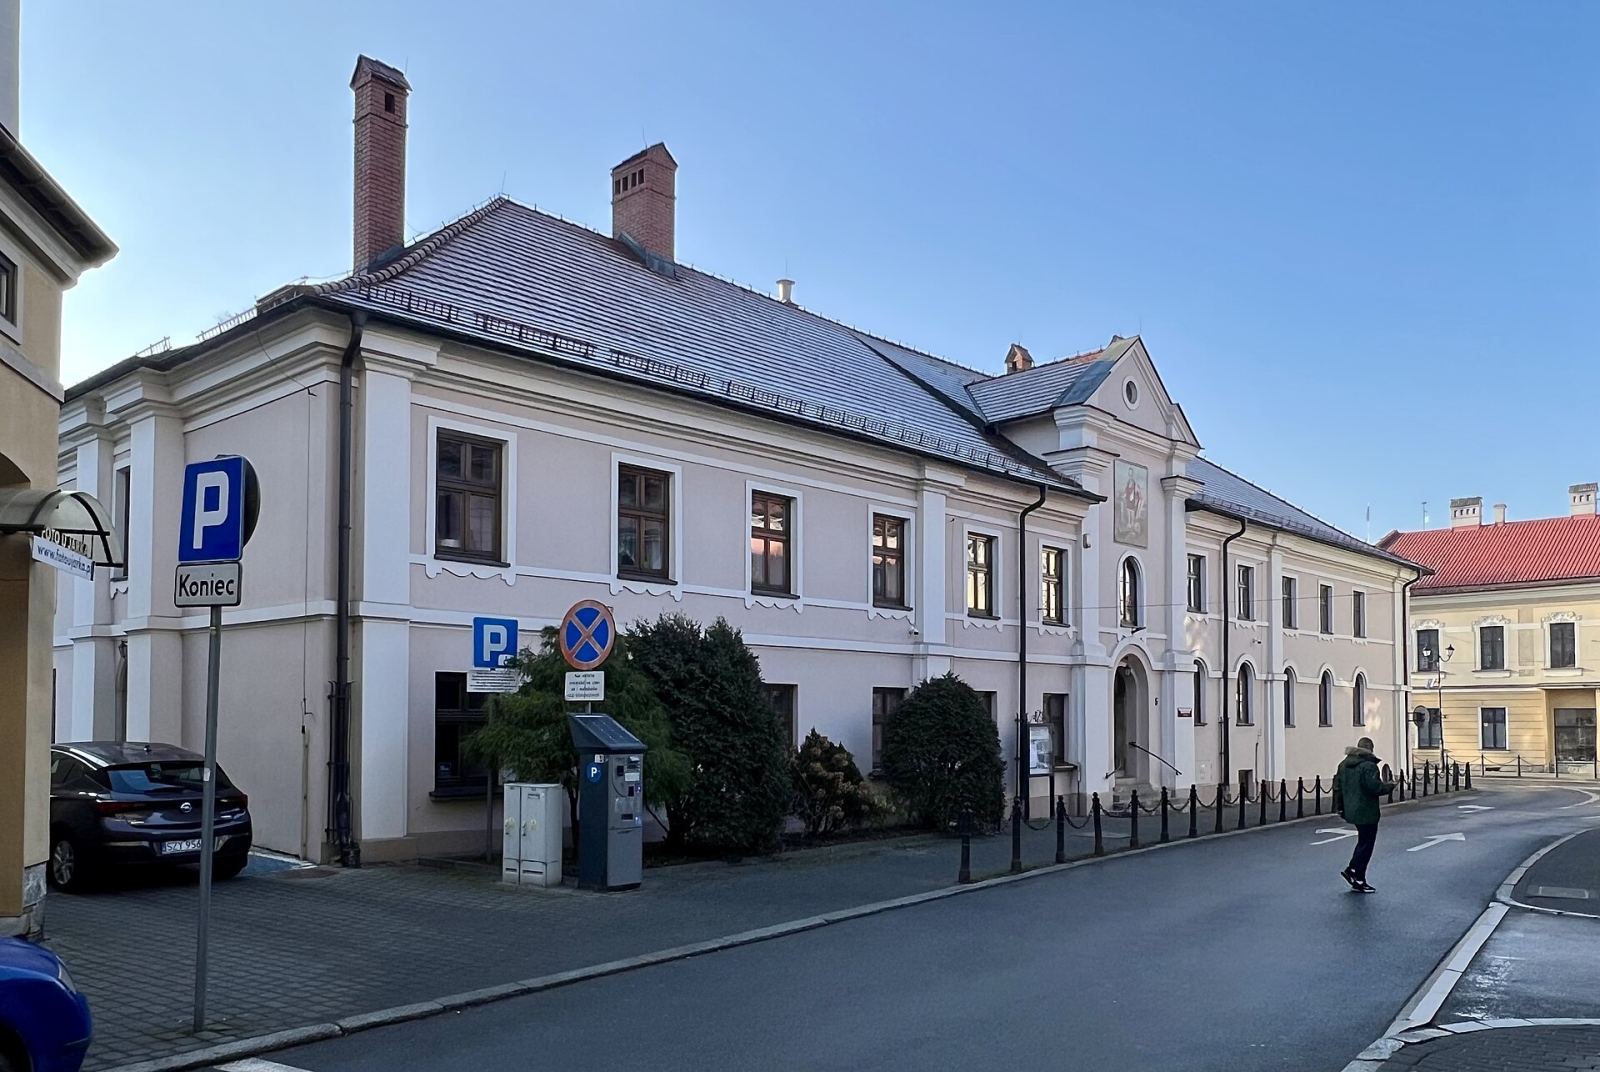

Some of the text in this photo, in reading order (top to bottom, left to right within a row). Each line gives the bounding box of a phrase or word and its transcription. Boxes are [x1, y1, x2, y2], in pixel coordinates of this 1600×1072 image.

[192, 470, 229, 550] P
[178, 573, 235, 597] Koniec
[483, 624, 508, 662] P
[591, 767, 598, 778] P
[166, 839, 201, 851] SZY 956
